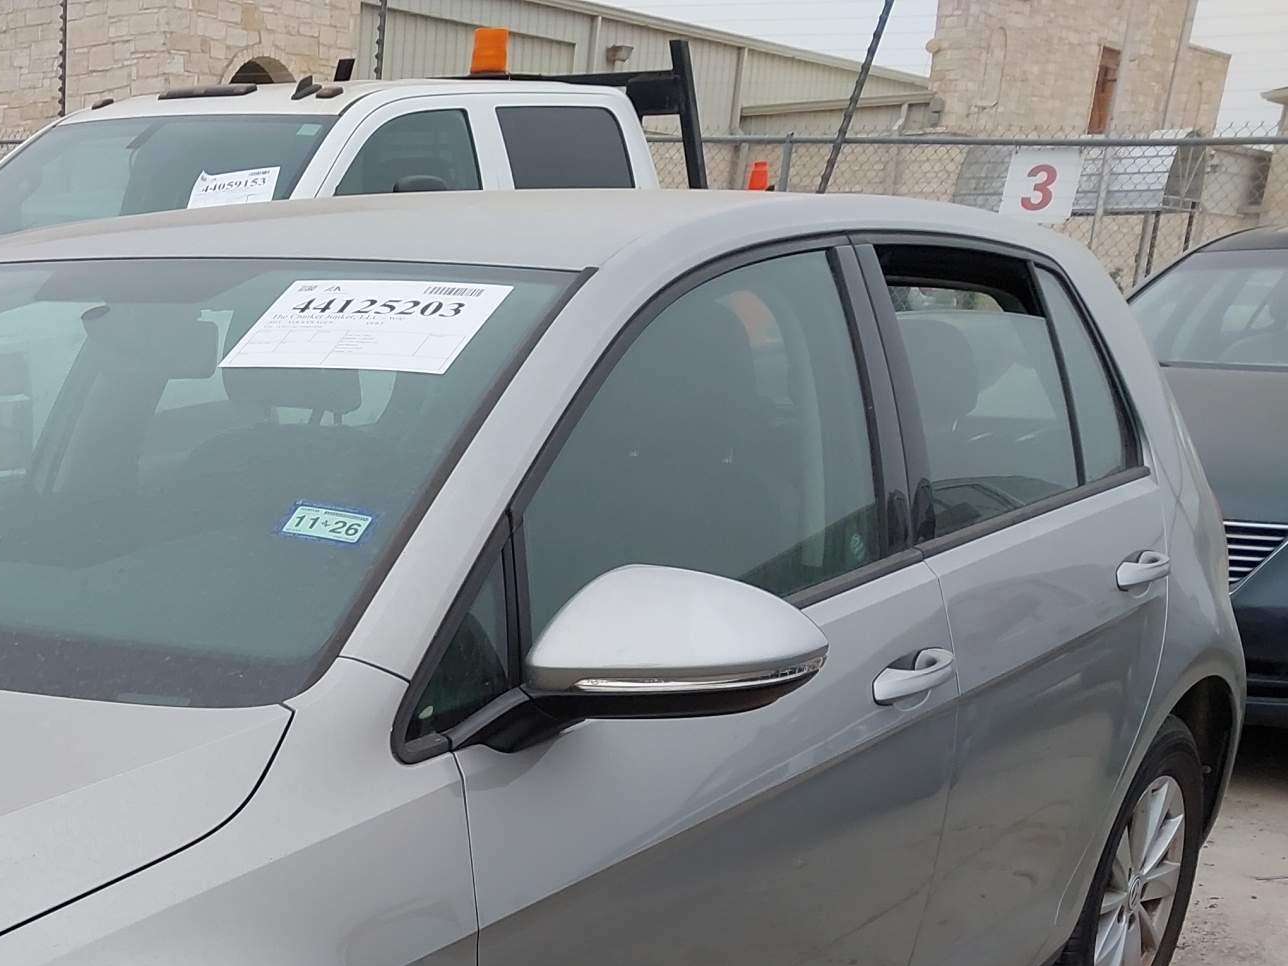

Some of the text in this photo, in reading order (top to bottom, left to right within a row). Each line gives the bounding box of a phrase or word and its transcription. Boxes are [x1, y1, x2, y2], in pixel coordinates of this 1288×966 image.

[1020, 164, 1058, 212] 3
[292, 297, 466, 317] 44125203
[294, 514, 321, 530] 11
[329, 520, 362, 536] 26
